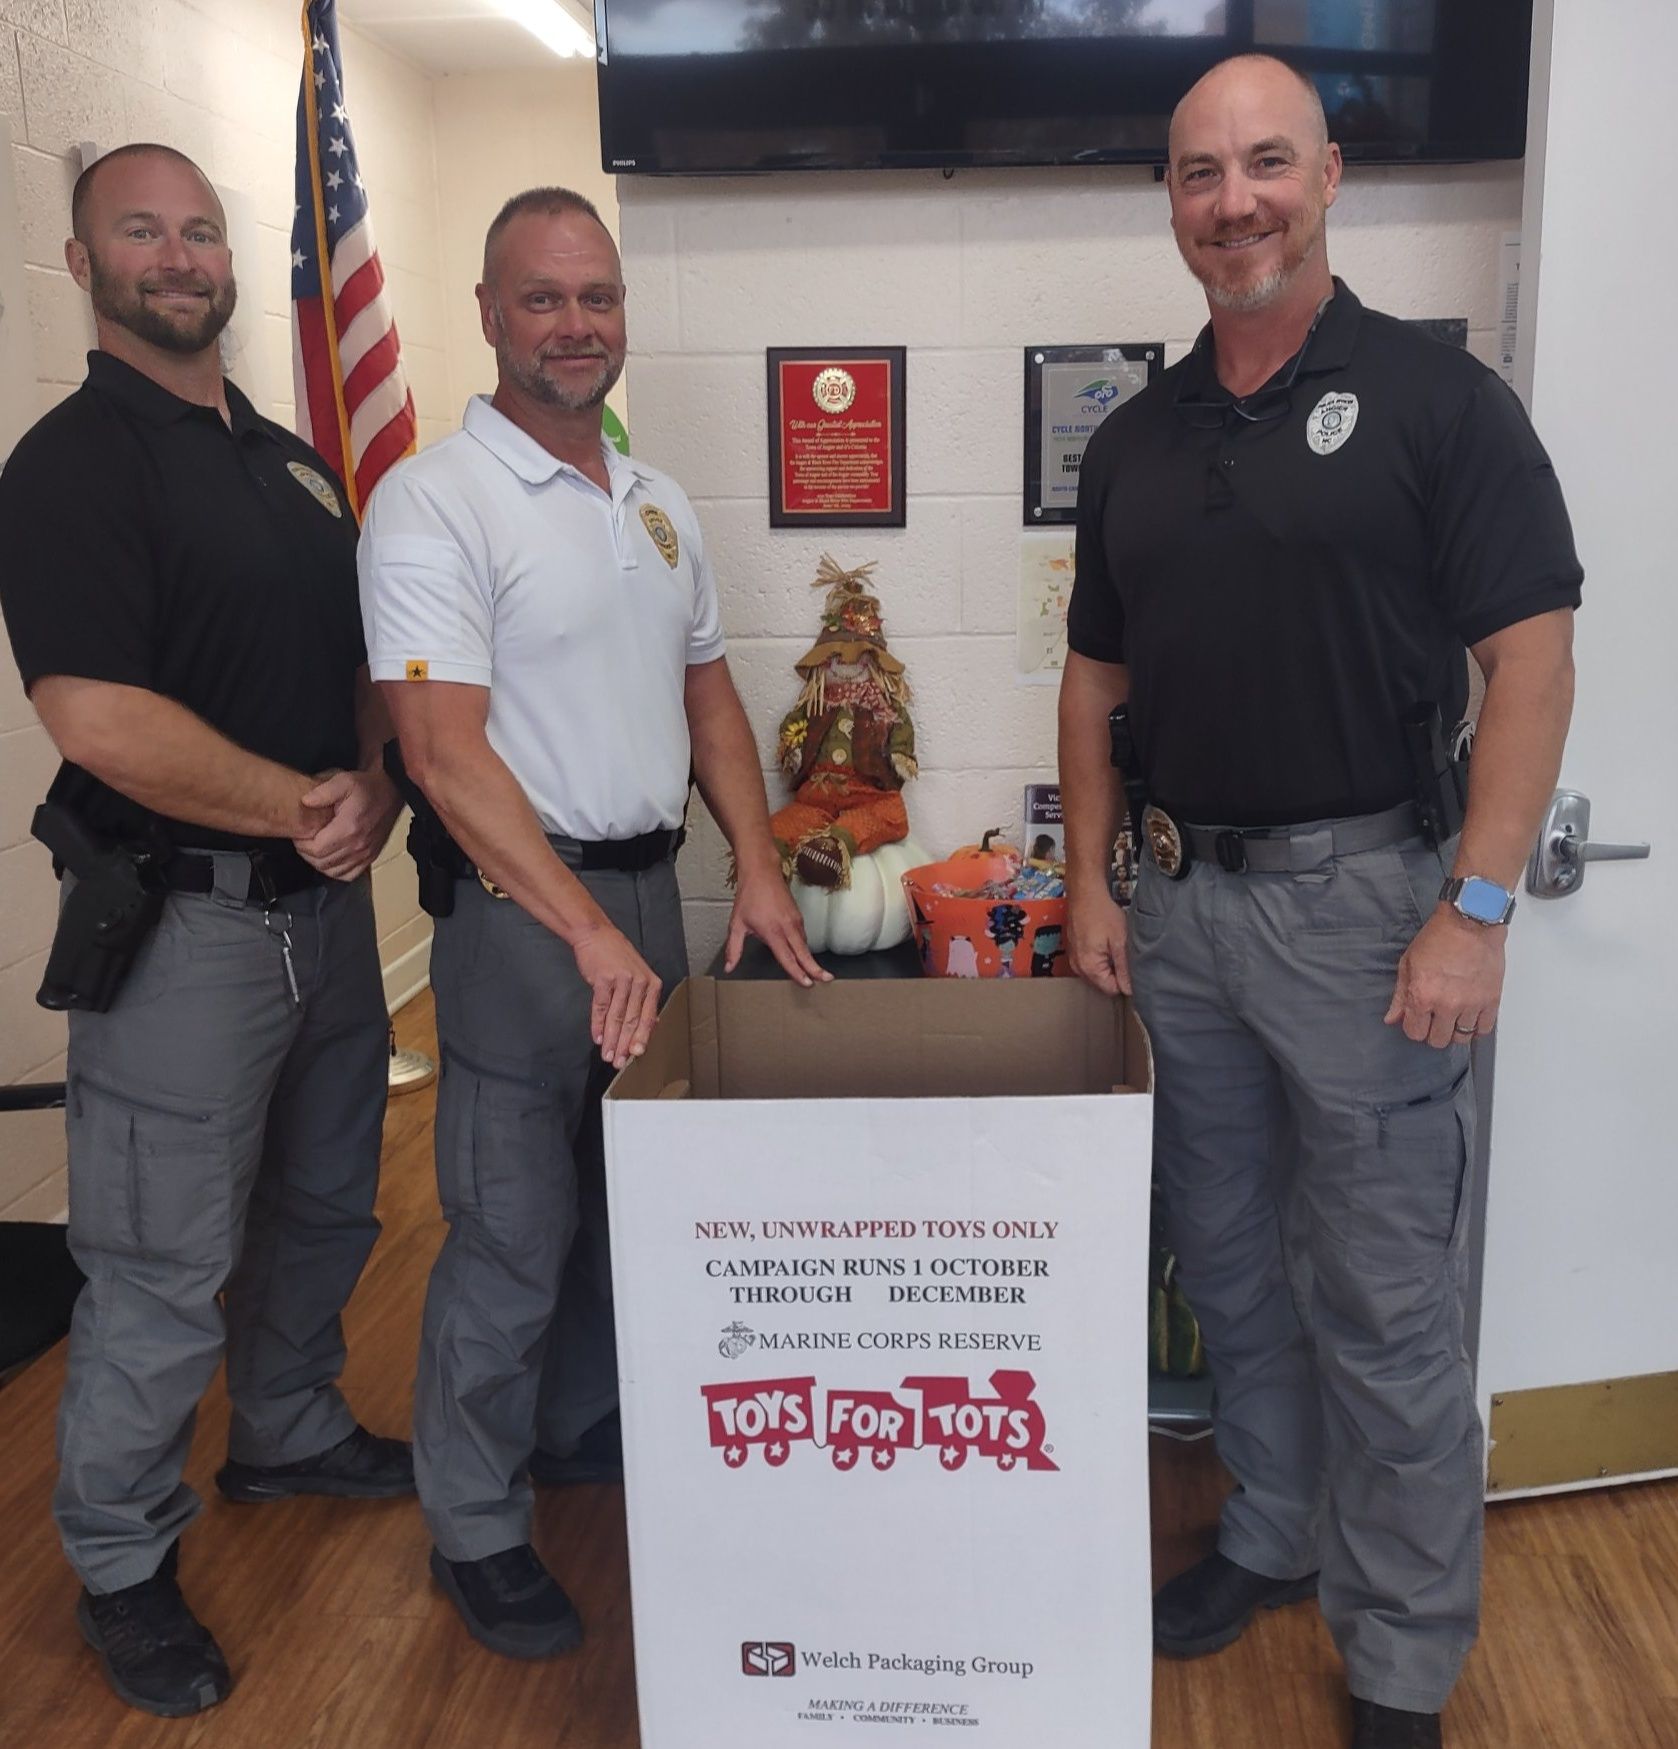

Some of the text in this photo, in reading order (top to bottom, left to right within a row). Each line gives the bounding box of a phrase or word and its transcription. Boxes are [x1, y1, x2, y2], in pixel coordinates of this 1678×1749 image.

[1081, 405, 1109, 414] CYCLE
[1052, 425, 1072, 433] CYCLE
[1063, 454, 1081, 463] BEST
[1062, 464, 1079, 472] TOW
[695, 1220, 1059, 1241] NEW, UNWRAPPED TOYS ONLY
[705, 1258, 1050, 1278] CAMPAIGN RUNS 1 OCTOBER
[729, 1285, 1027, 1304] THROUGH DECEMBER
[759, 1332, 1042, 1352] MARINE CORPS RESERVE
[712, 1390, 1031, 1449] TOYS FOR TOTS
[801, 1650, 1034, 1678] Welch Packaging Group
[808, 1699, 969, 1716] MAKING A DIFFERENCE
[798, 1713, 980, 1726] FAMILY COMMUNITY BUSINESS
